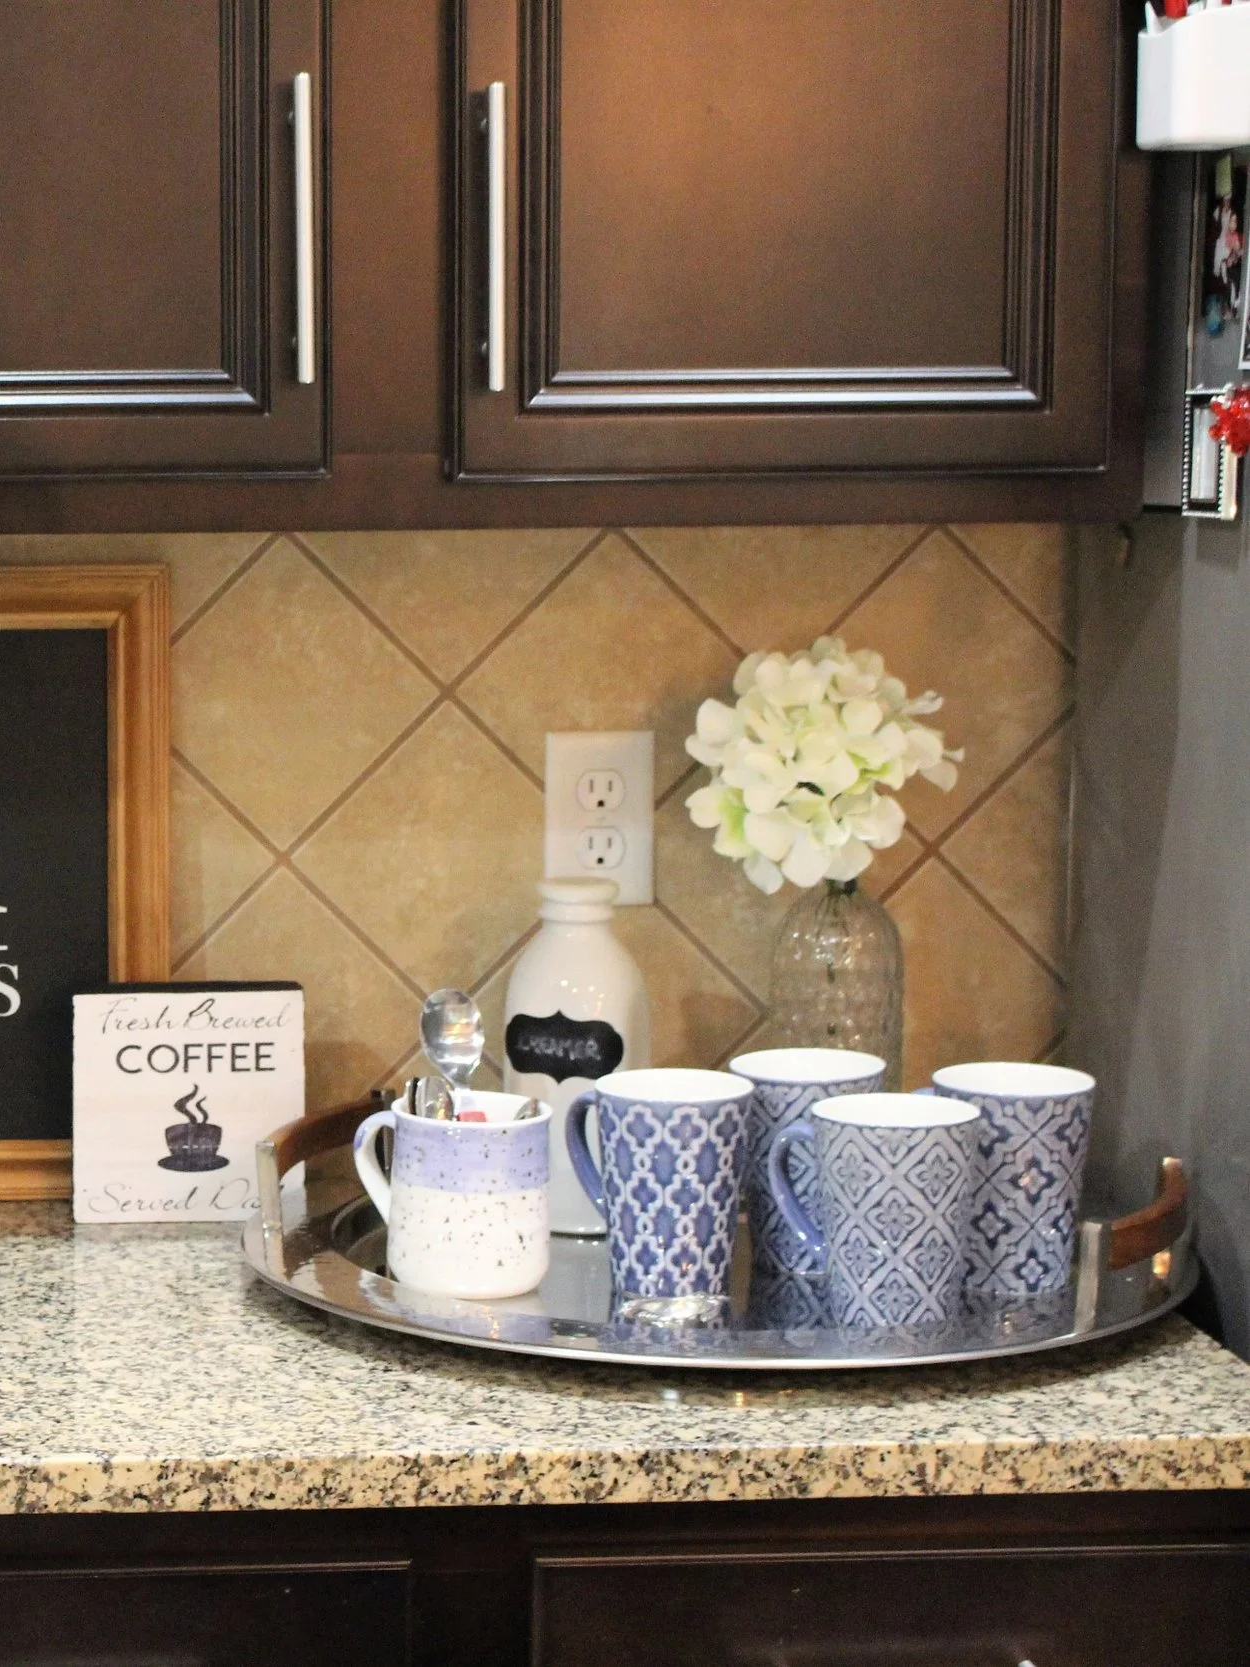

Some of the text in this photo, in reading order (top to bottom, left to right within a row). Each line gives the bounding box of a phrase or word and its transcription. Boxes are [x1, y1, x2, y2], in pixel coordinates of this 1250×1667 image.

[100, 997, 291, 1034] Fresh Brewed
[116, 1042, 276, 1074] COFFEE
[88, 1183, 199, 1214] Served
